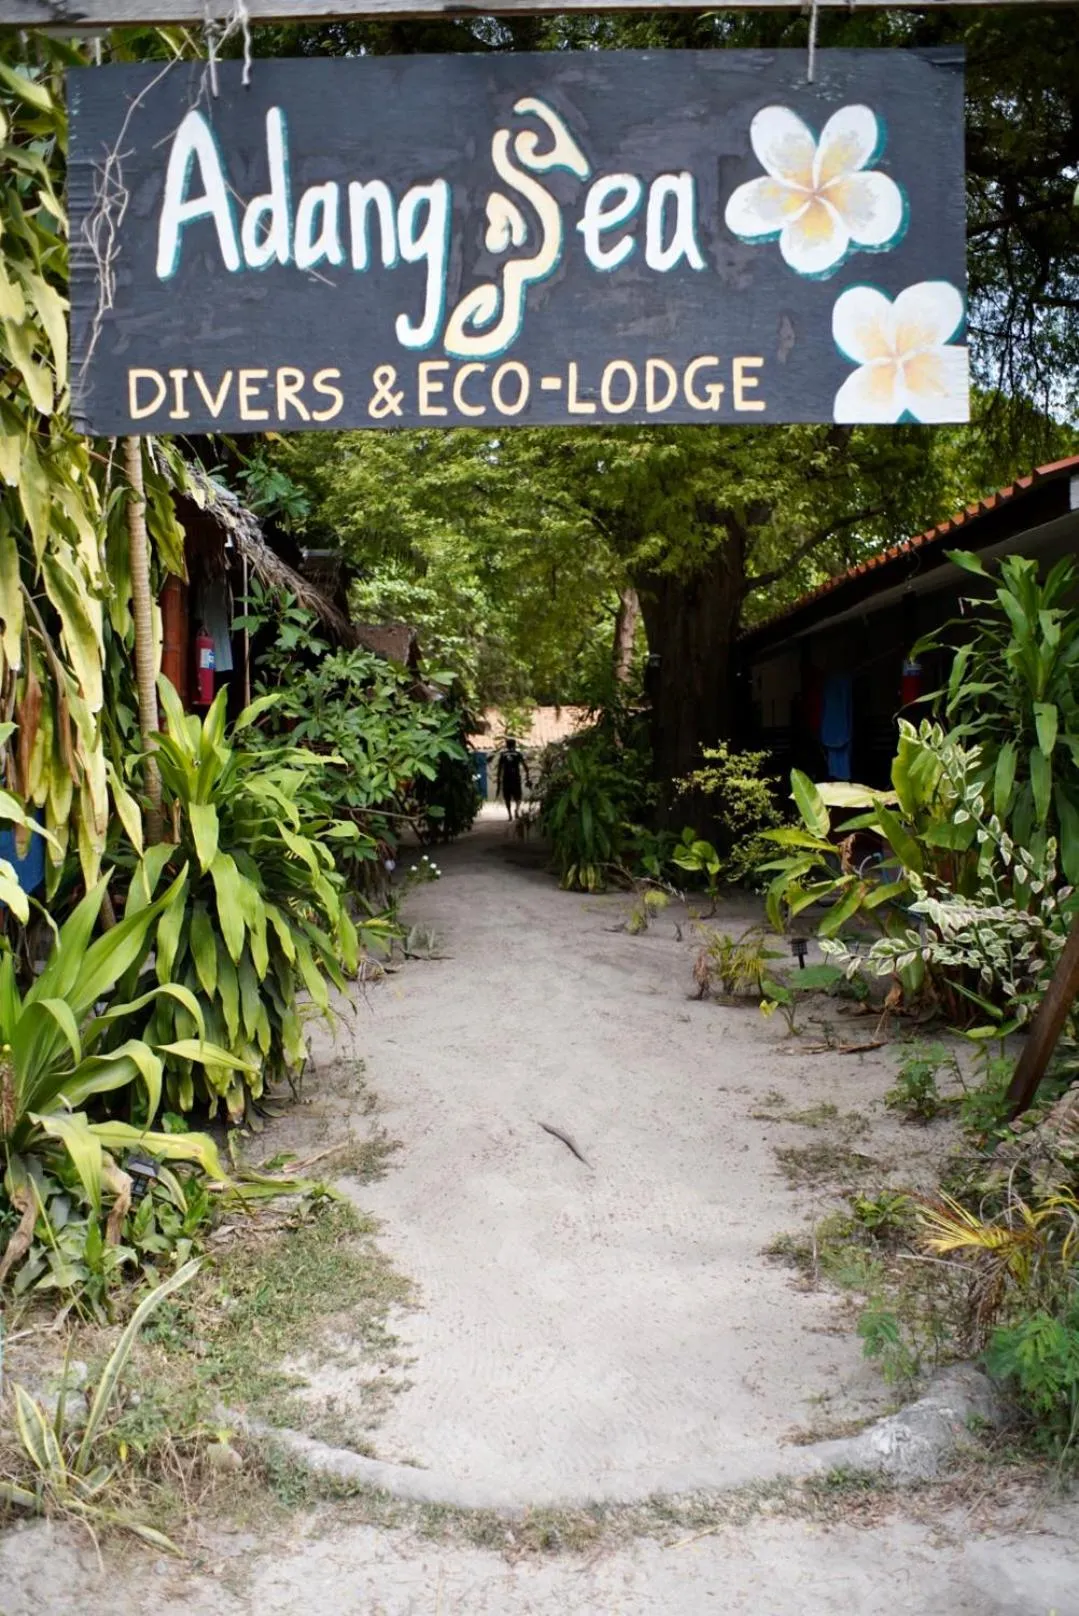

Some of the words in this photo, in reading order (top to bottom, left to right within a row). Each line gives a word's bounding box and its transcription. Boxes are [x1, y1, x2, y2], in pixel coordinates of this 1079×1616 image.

[155, 106, 452, 350] Adang
[443, 97, 708, 359] Sea
[128, 367, 344, 421] DIVERS
[368, 364, 405, 419] &
[418, 356, 766, 416] ECO-LODGE
